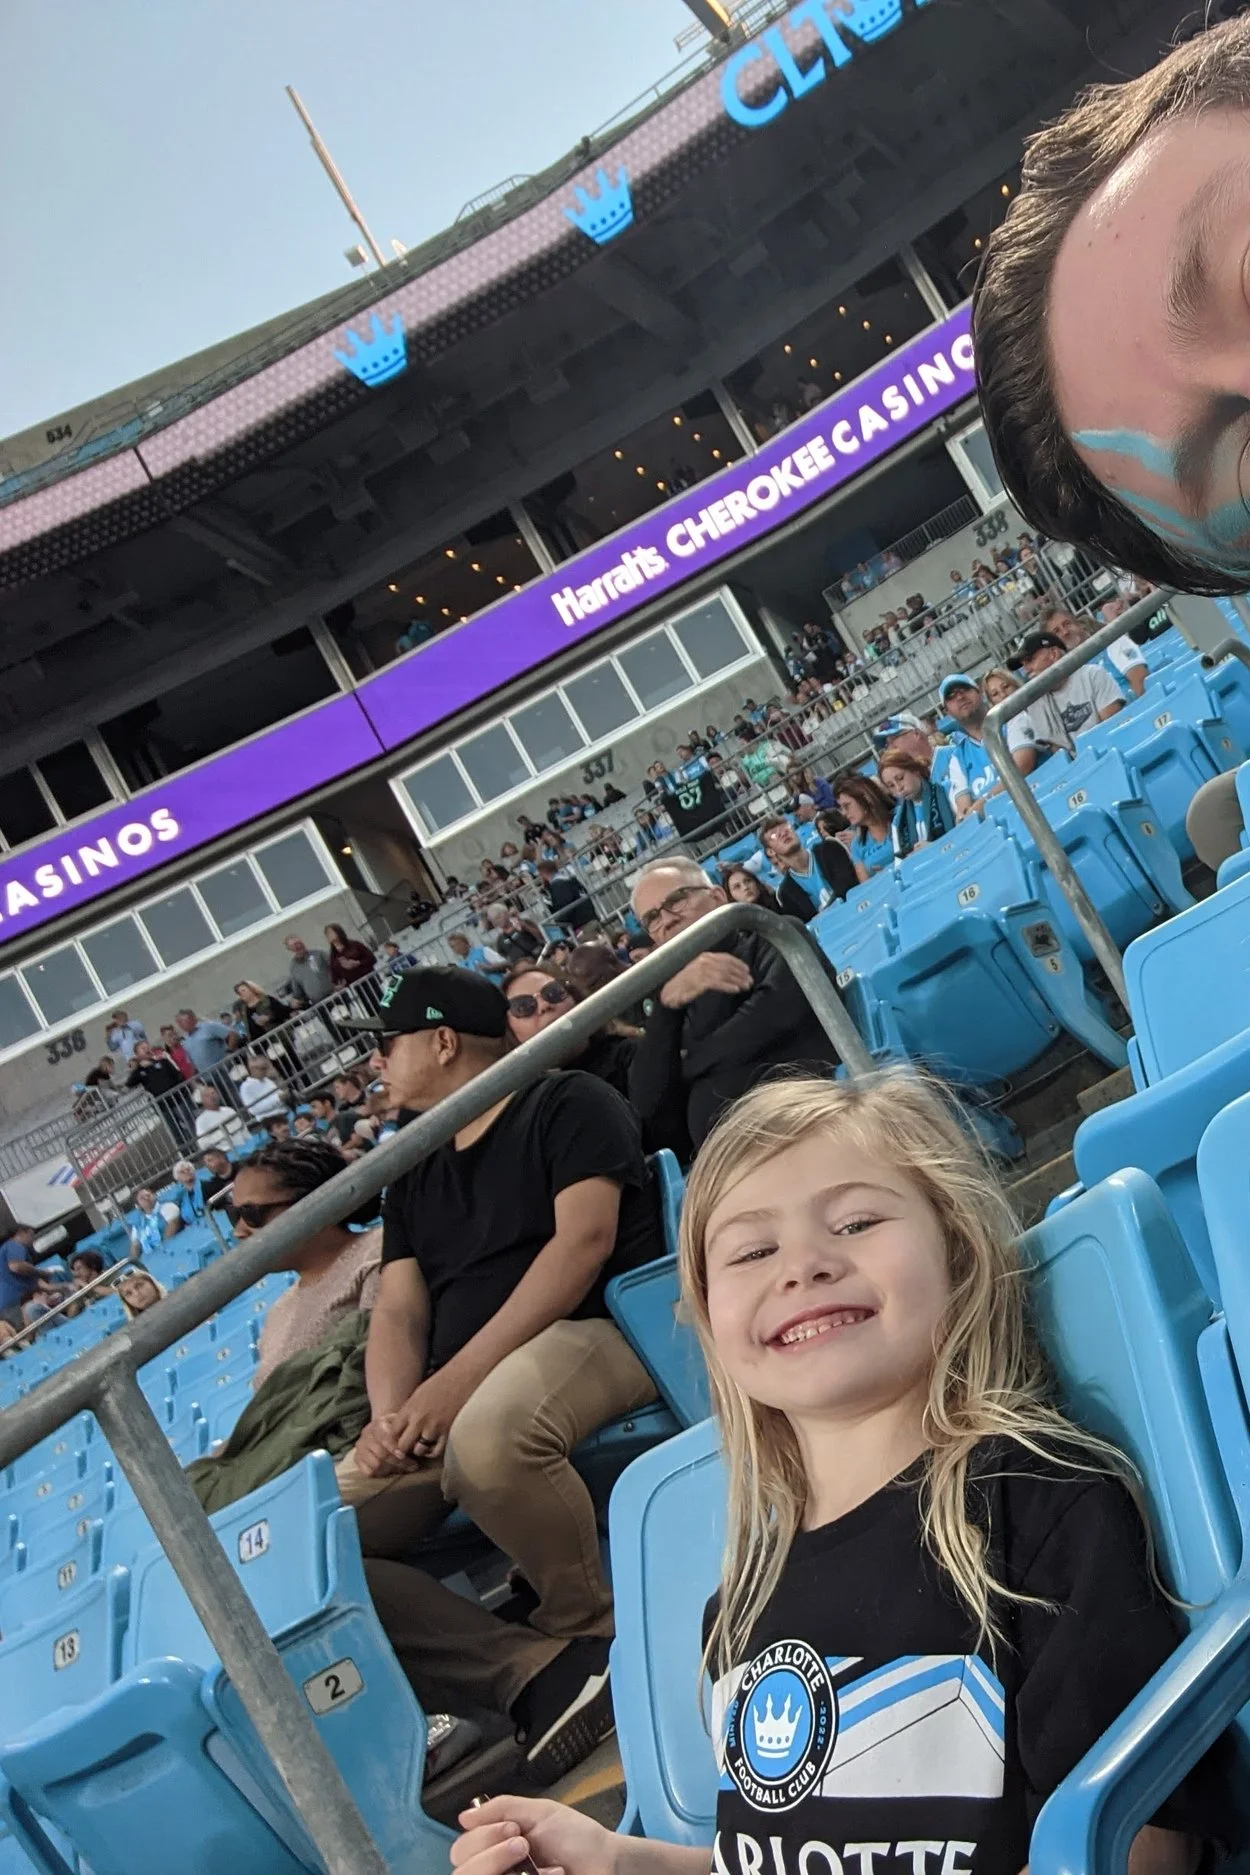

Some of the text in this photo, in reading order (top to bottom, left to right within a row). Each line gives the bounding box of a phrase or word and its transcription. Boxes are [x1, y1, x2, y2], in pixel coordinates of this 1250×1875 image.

[666, 435, 836, 557] CHEROKEE
[580, 747, 614, 785] 337
[0, 807, 179, 924] ASINOS
[245, 1526, 264, 1555] 14
[324, 1674, 346, 1701] 2
[741, 1645, 826, 1693] CHARLOTTE
[734, 1757, 817, 1804] FOOTBALL CLUB
